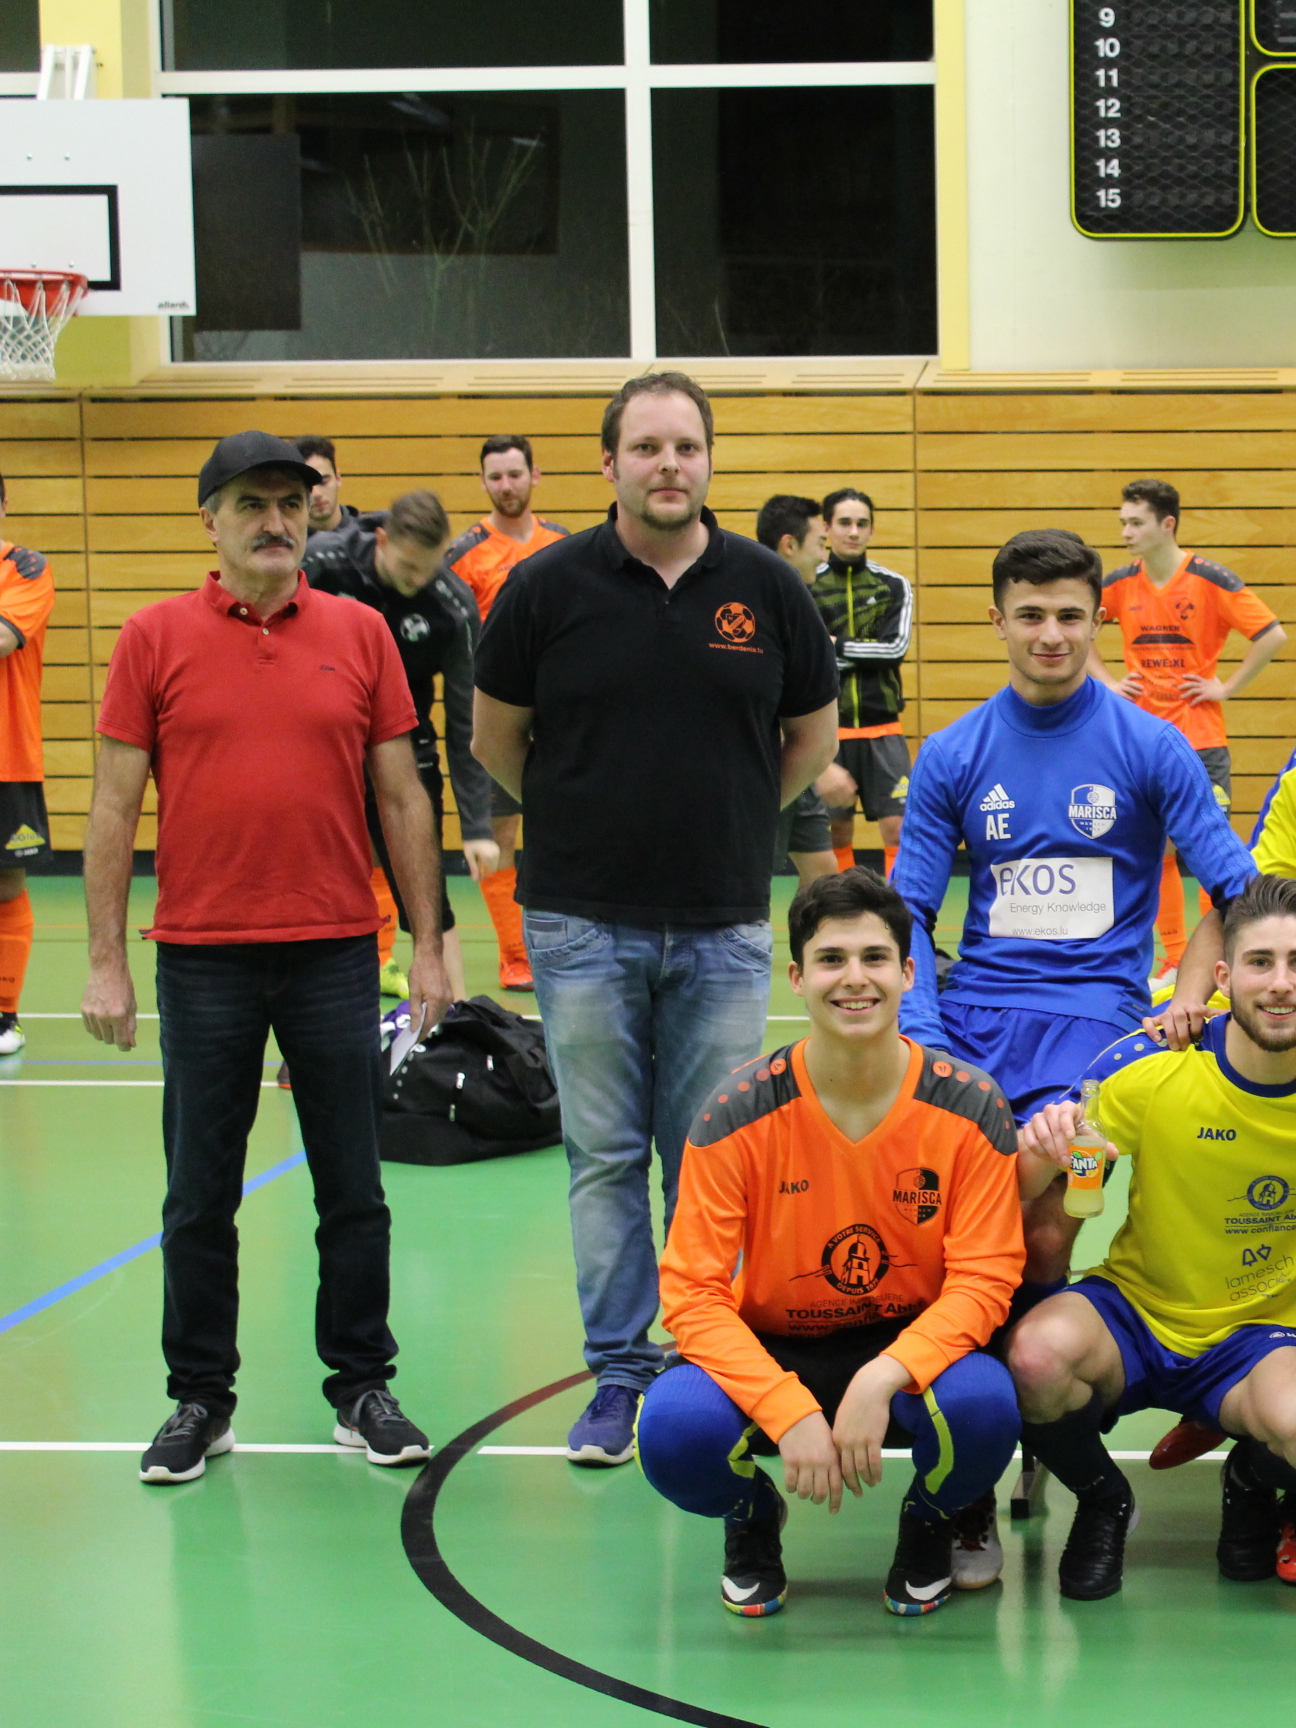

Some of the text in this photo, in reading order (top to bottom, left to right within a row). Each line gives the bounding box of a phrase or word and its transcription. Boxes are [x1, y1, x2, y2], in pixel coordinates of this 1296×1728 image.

[1098, 7, 1116, 28] 9
[1094, 37, 1121, 58] 10
[1094, 67, 1119, 88] 11
[1095, 97, 1122, 118] 12
[1095, 127, 1122, 148] 13
[1095, 158, 1122, 178] 14
[1096, 188, 1122, 208] 15
[979, 799, 1016, 812] adidas
[1068, 805, 1118, 820] MARISCA
[985, 812, 1012, 841] AE
[1010, 901, 1107, 915] Energy Knowledge
[1012, 926, 1069, 936] www.ekos.lu
[1197, 1127, 1237, 1141] JAKO
[779, 1180, 809, 1194] JAKO
[893, 1189, 942, 1206] MARISCA
[1224, 1216, 1281, 1225] TOUSSAINT
[832, 1227, 854, 1243] VOTRE
[855, 1226, 881, 1243] SERVICE
[1226, 1254, 1295, 1290] lamesch
[837, 1282, 864, 1294] DEPUIS
[785, 1302, 883, 1319] TOUSSAINT
[810, 1299, 847, 1308] AGENCE
